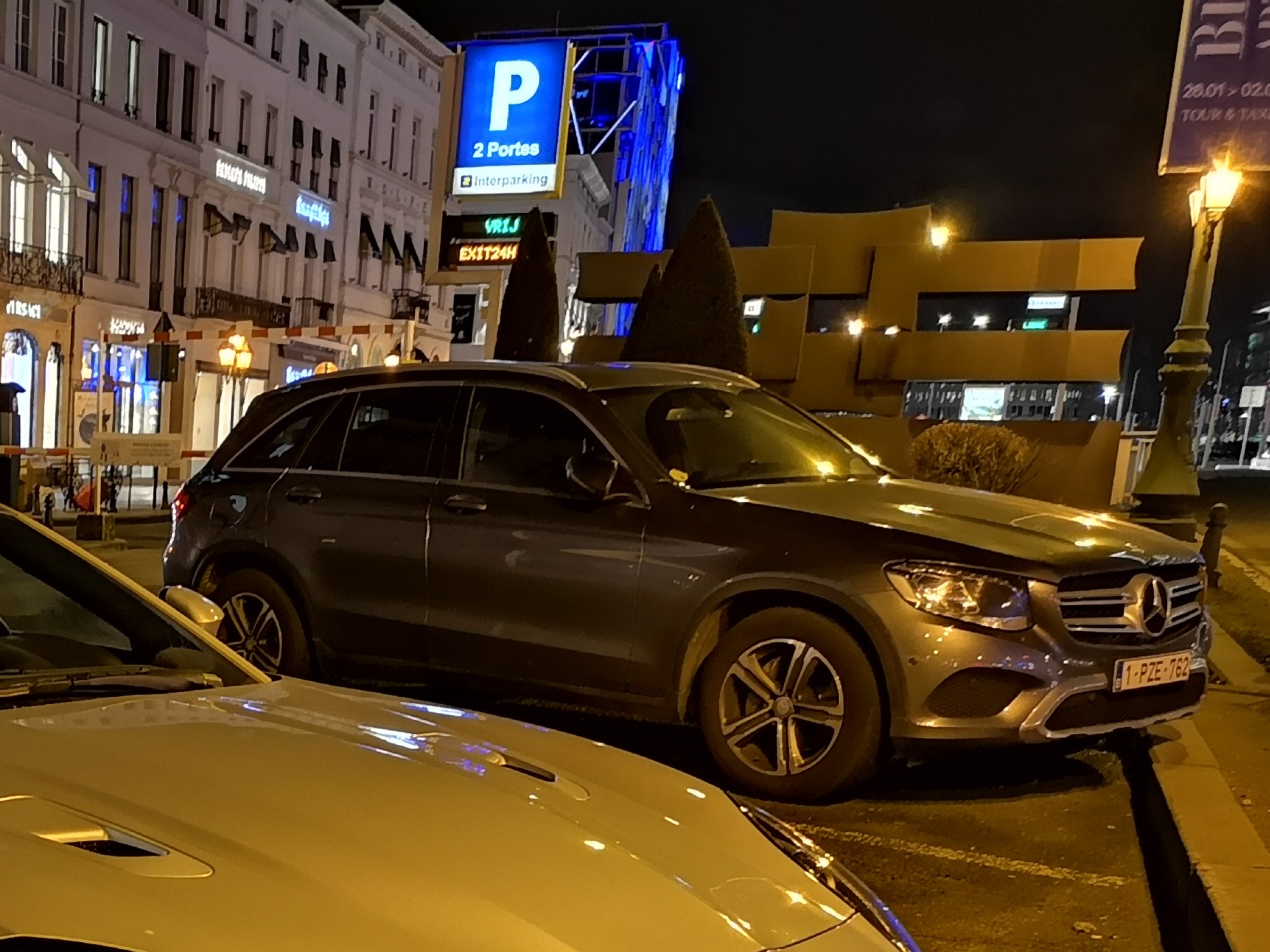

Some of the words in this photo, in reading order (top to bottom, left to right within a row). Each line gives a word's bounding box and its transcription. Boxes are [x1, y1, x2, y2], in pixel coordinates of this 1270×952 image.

[489, 60, 540, 132] P
[1181, 107, 1224, 122] TOUR
[473, 143, 484, 159] 2
[487, 141, 540, 158] Portes
[474, 174, 549, 188] Interparking
[485, 216, 522, 235] VRIJ
[458, 243, 519, 262] EXIT24H
[1125, 656, 1189, 686] 1-PZE-762
